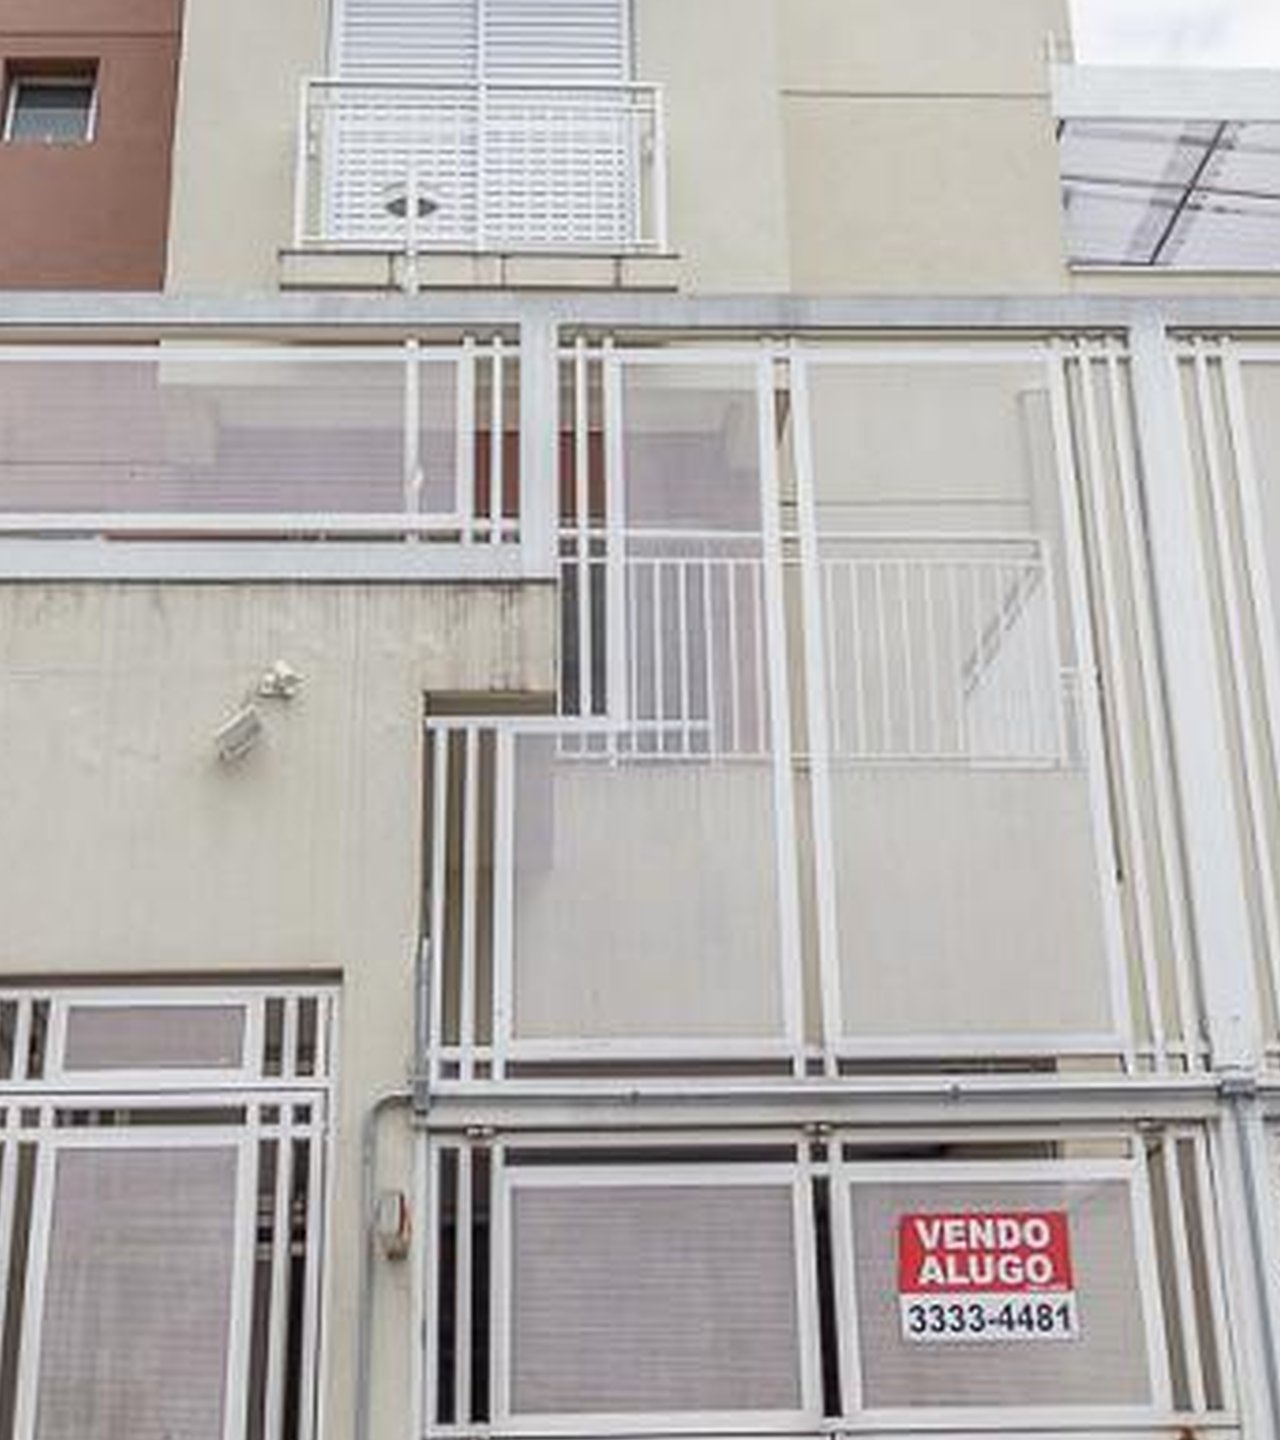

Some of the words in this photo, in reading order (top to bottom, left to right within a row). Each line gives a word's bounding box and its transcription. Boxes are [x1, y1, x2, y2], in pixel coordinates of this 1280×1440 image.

[915, 1218, 1051, 1250] VENDO
[918, 1254, 1055, 1285] ALUGO
[909, 1303, 1072, 1333] 3333-4481
